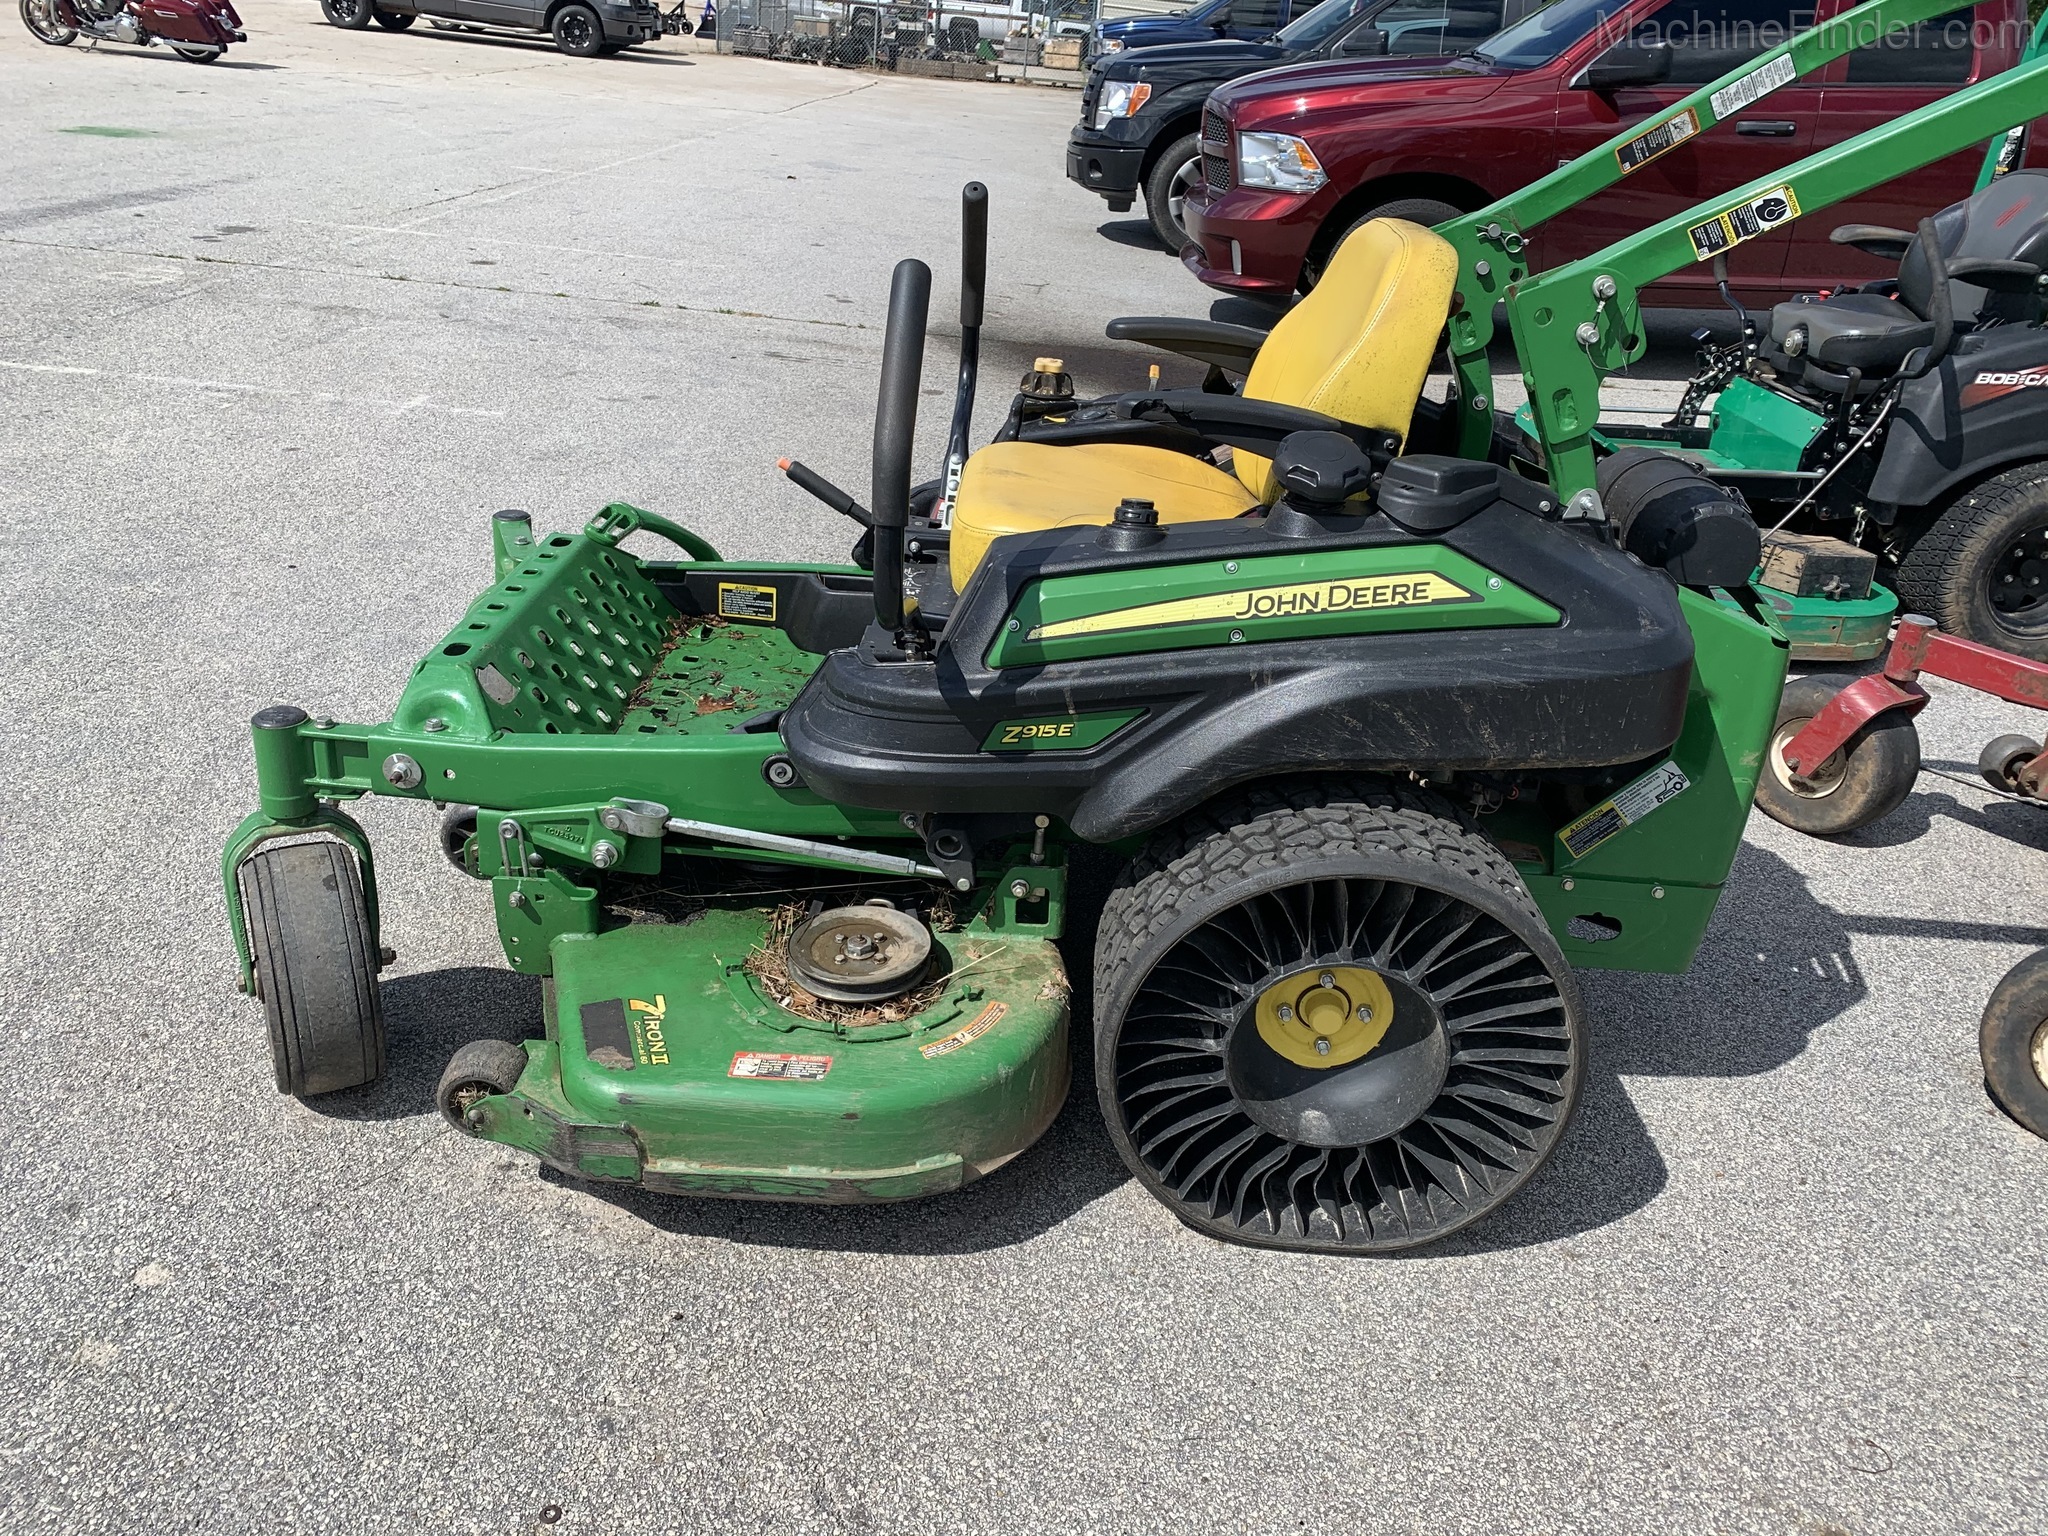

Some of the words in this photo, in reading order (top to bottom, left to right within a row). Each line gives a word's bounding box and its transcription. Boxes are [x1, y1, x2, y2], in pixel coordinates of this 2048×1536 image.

[1786, 189, 1800, 215] CAUTION
[1236, 591, 1320, 616] JOHN
[1328, 582, 1431, 609] DEERE
[1001, 723, 1075, 743] Z915E
